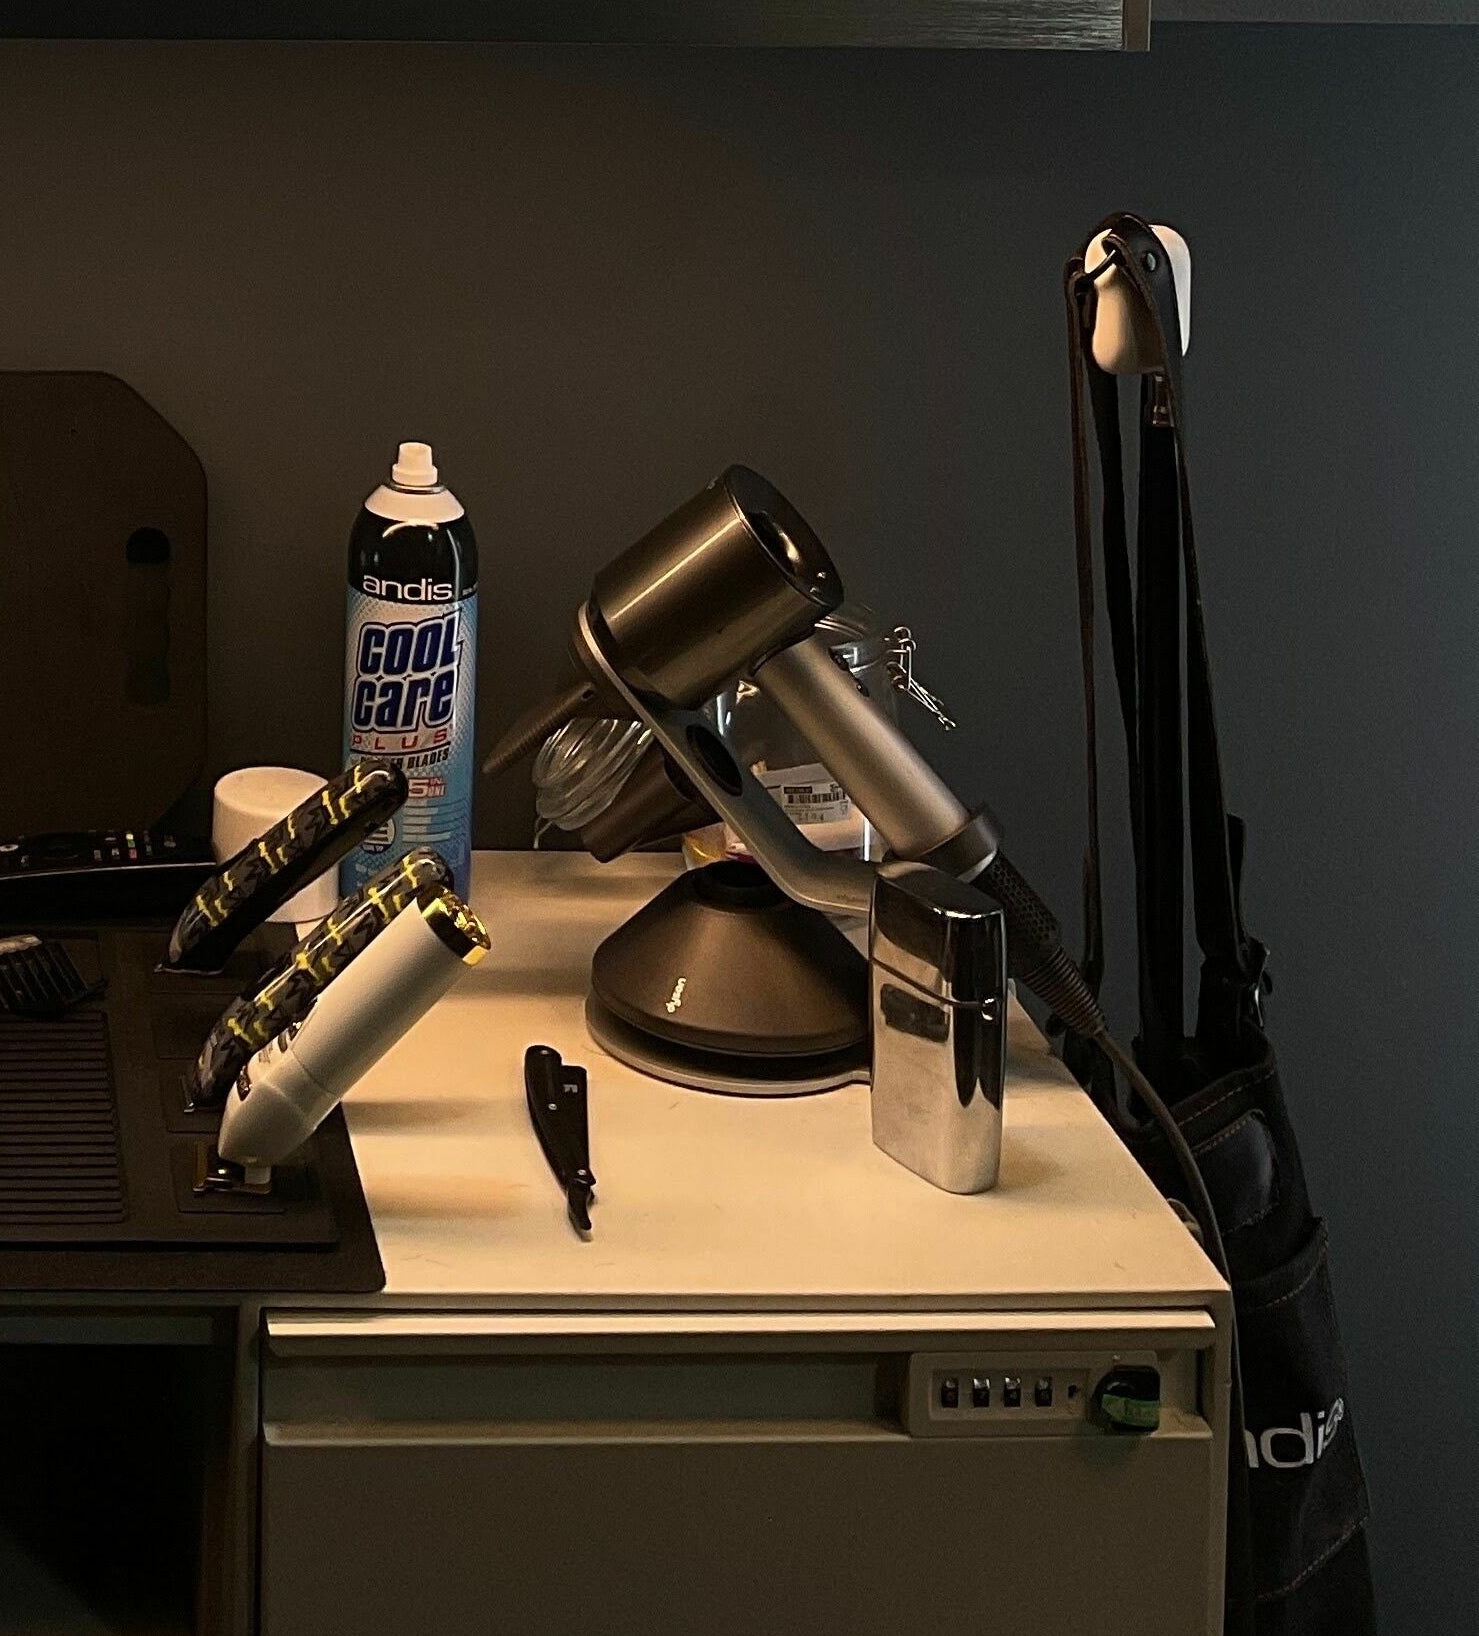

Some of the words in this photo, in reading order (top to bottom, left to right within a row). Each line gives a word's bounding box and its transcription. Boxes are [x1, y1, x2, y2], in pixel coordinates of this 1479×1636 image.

[362, 574, 453, 601] andis
[352, 728, 448, 750] PLUS
[407, 748, 450, 769] BLADES
